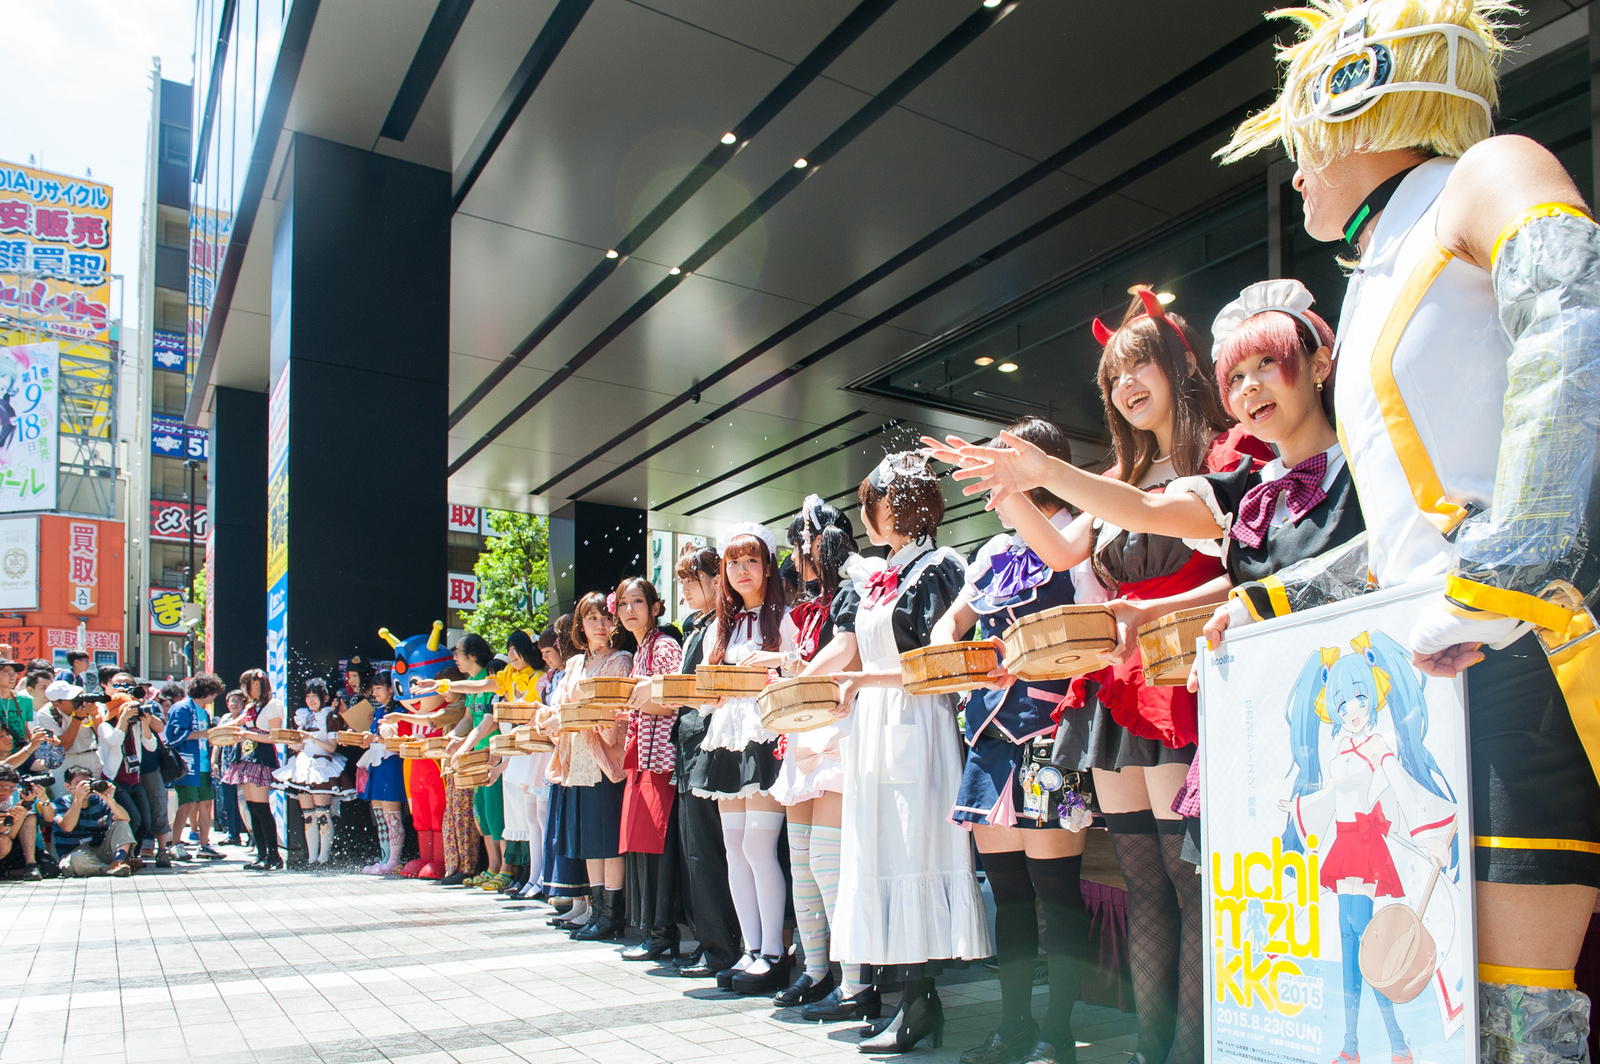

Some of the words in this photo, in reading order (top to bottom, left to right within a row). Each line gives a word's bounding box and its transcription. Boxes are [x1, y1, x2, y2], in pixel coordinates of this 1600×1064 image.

[0, 200, 105, 246] 安販売
[154, 339, 185, 350] アメニティ
[152, 424, 184, 434] アメニティ
[451, 505, 476, 528] 取
[73, 525, 94, 583] 買取
[78, 589, 88, 606] 入口
[450, 578, 476, 604] 取
[1211, 654, 1235, 667] licolita
[1280, 982, 1322, 1007] 2015
[1217, 1008, 1322, 1045] 2015.8.23(SUN)
